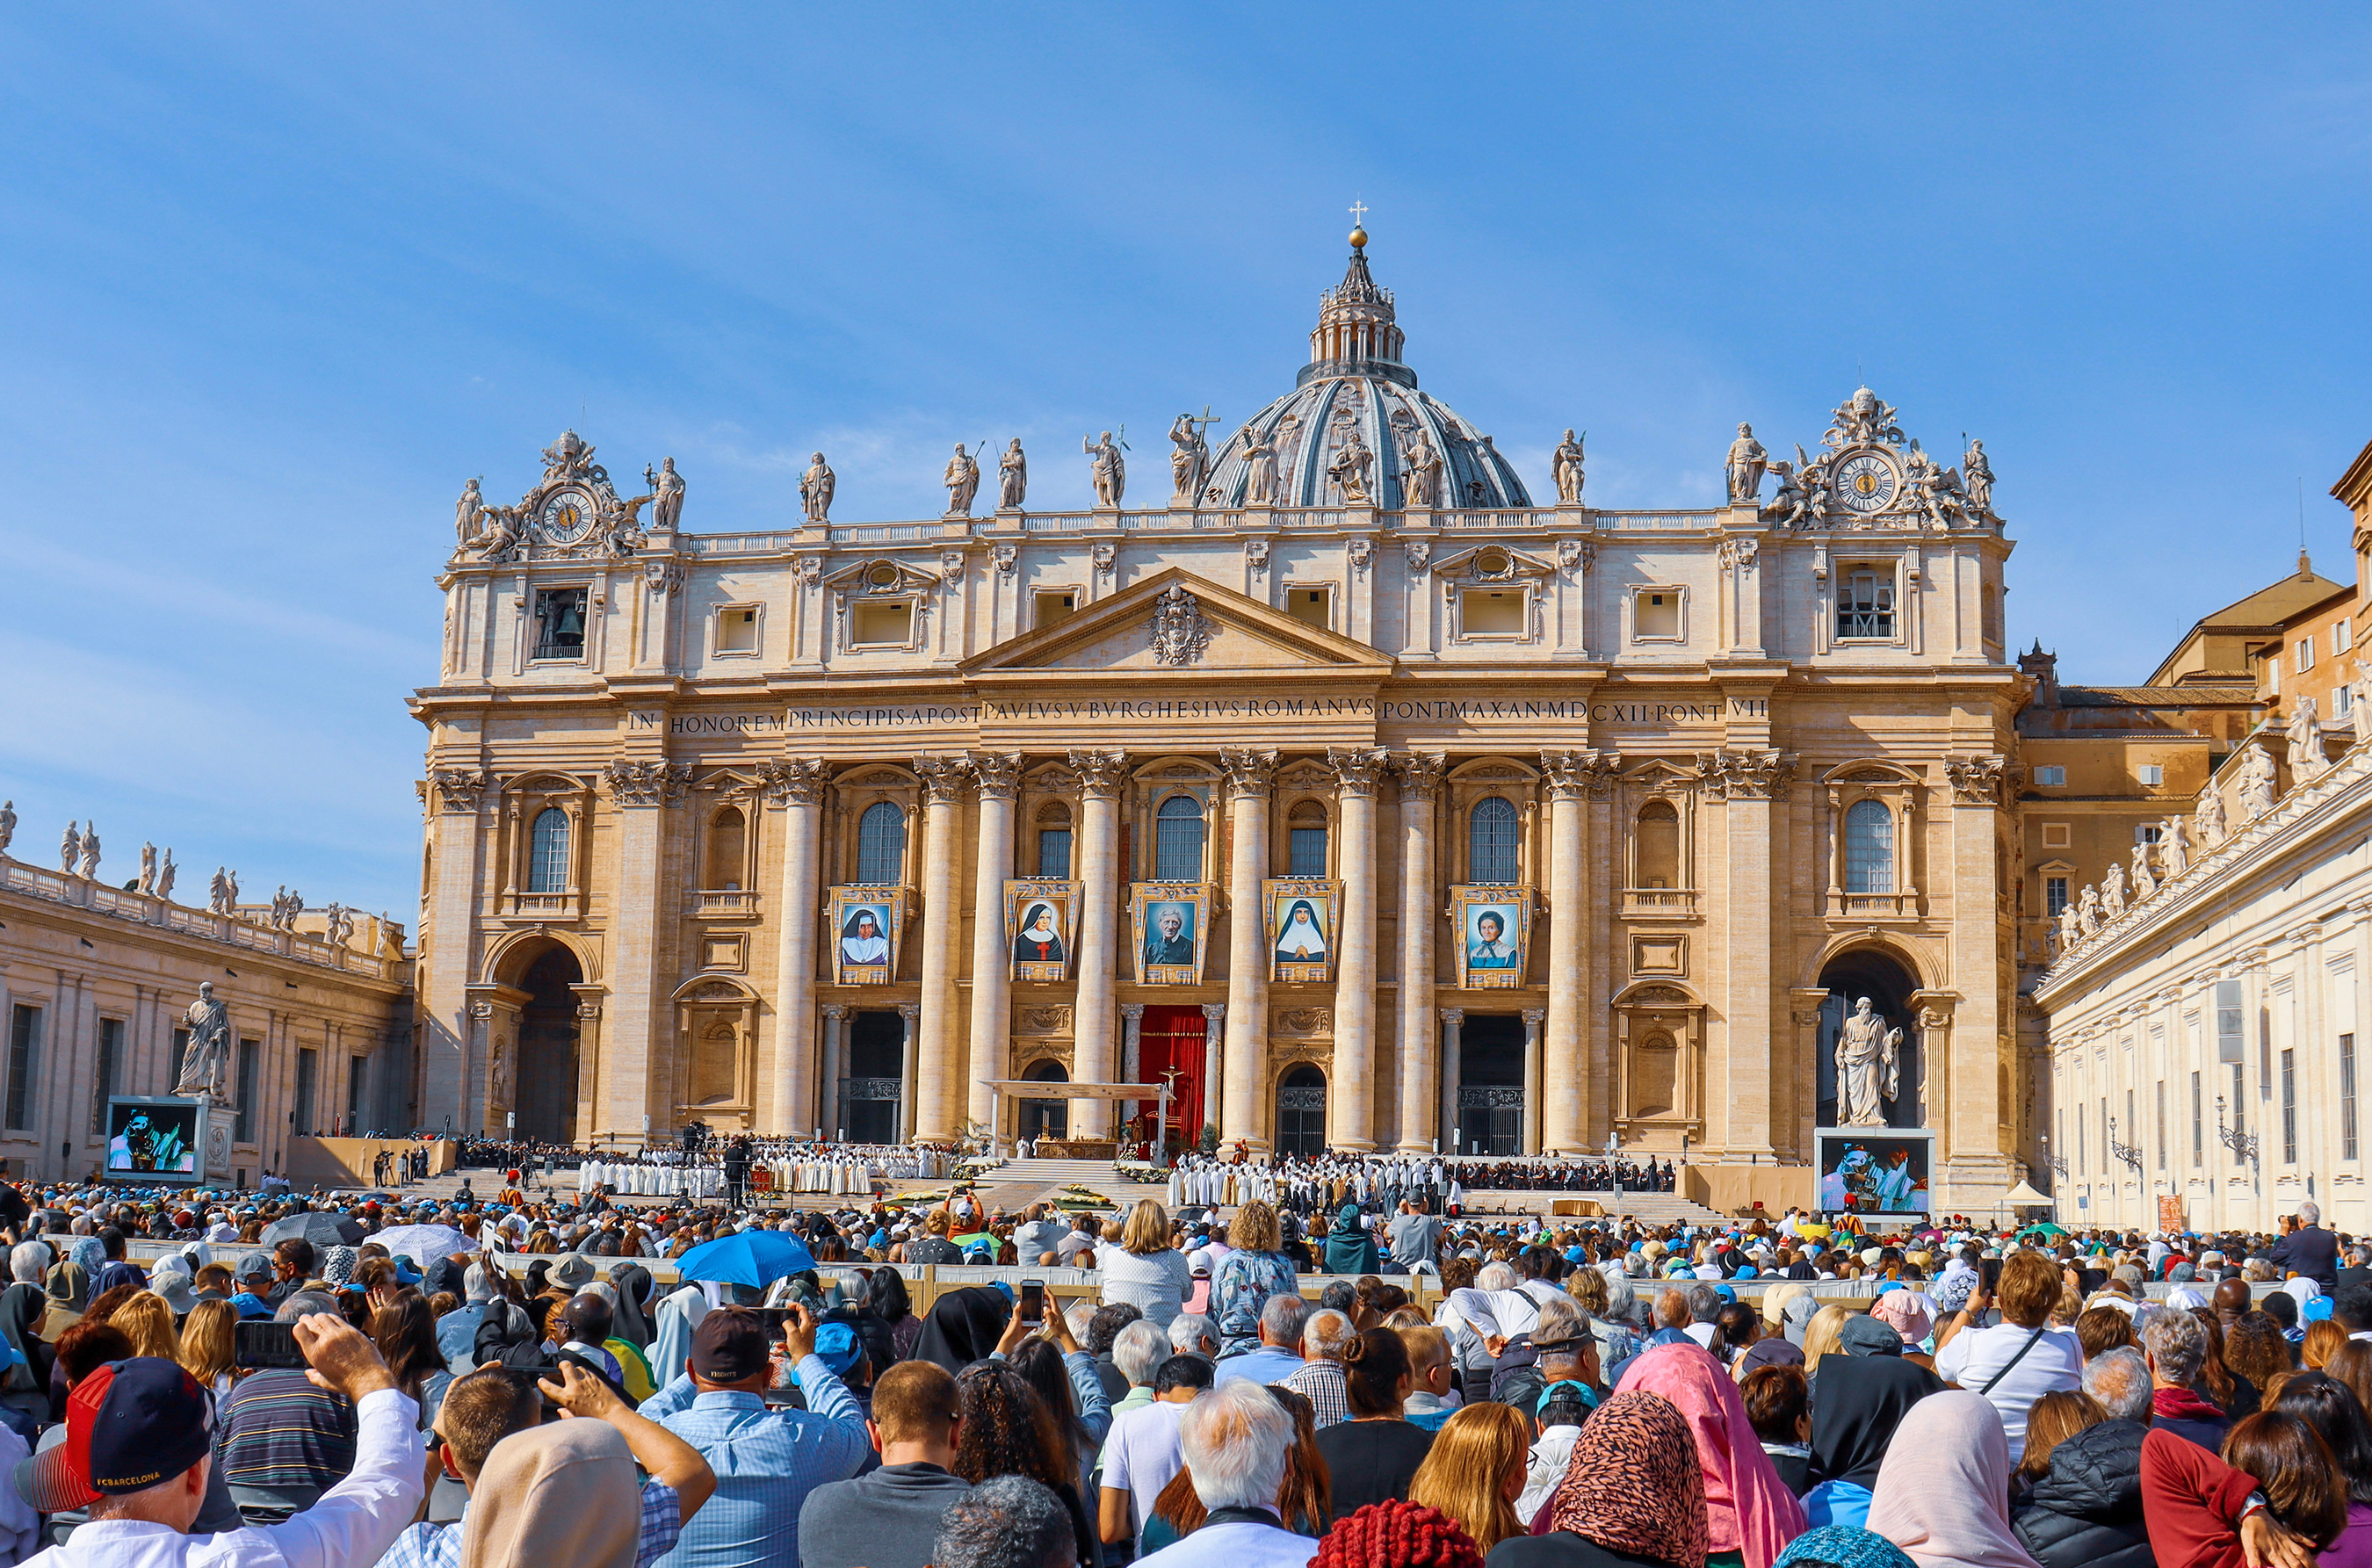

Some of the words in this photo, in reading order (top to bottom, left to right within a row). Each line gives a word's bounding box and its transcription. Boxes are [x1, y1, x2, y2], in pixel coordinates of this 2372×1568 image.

[630, 713, 655, 730] IN
[670, 715, 785, 733] HONOREM
[788, 709, 905, 727] PRINCIPIS
[909, 706, 982, 724] APOST
[983, 702, 1063, 719] PAVLVS
[1067, 702, 1081, 719] V
[1088, 700, 1240, 719] BVRGHESIVS
[1247, 698, 1374, 717] ROMANVS
[1382, 701, 1448, 719] PONT
[1450, 701, 1504, 719] MAX
[1508, 701, 1541, 718] AN
[1655, 705, 1722, 722] PONT
[1732, 699, 1767, 717] VII
[429, 1249, 451, 1260] Berlin
